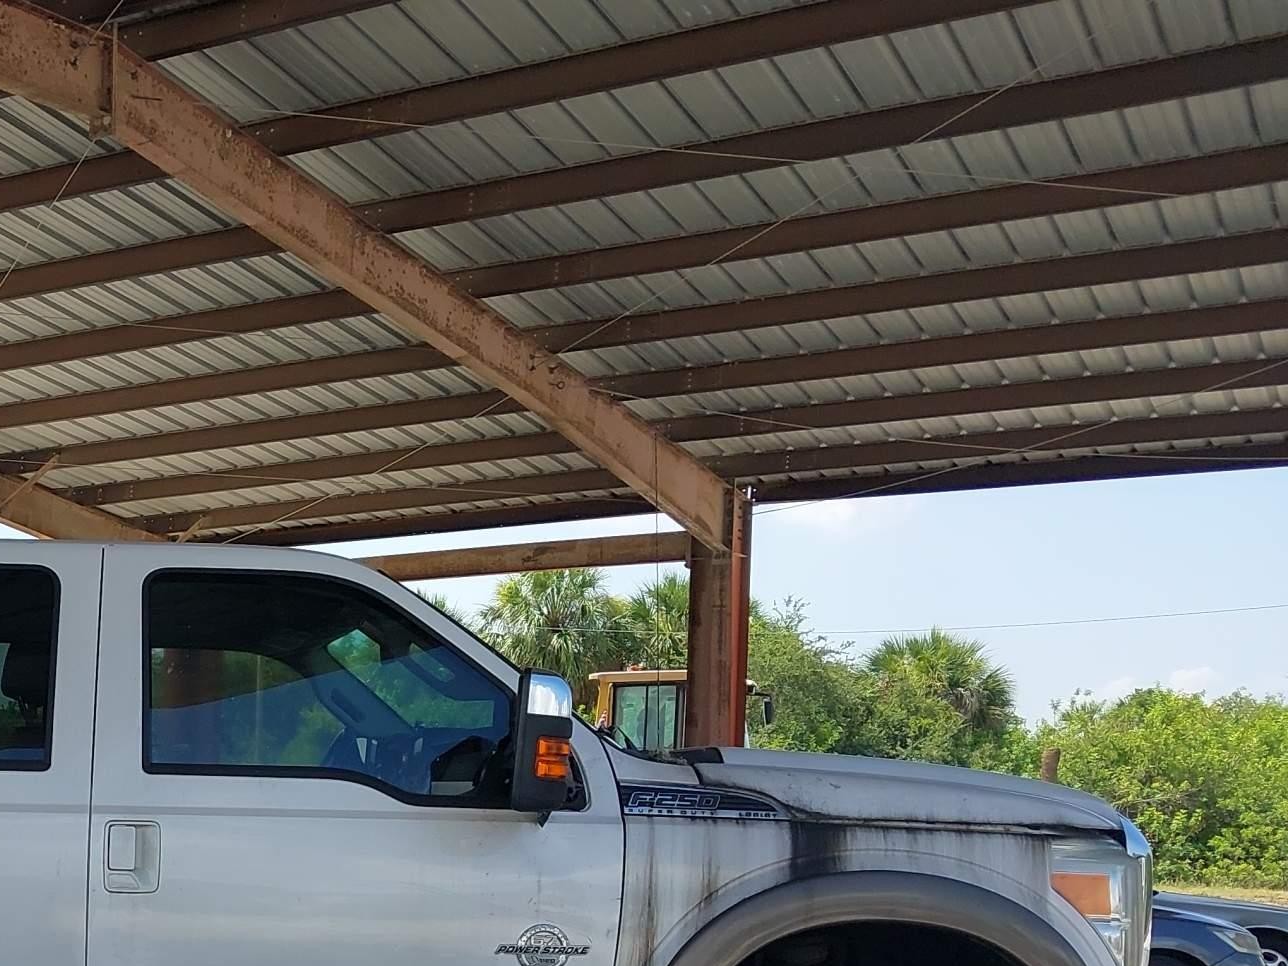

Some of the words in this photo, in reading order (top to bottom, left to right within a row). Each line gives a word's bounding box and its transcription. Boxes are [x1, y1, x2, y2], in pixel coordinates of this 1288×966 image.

[629, 792, 721, 810] F-250
[496, 945, 540, 955] POWER
[541, 946, 590, 956] STROKE
